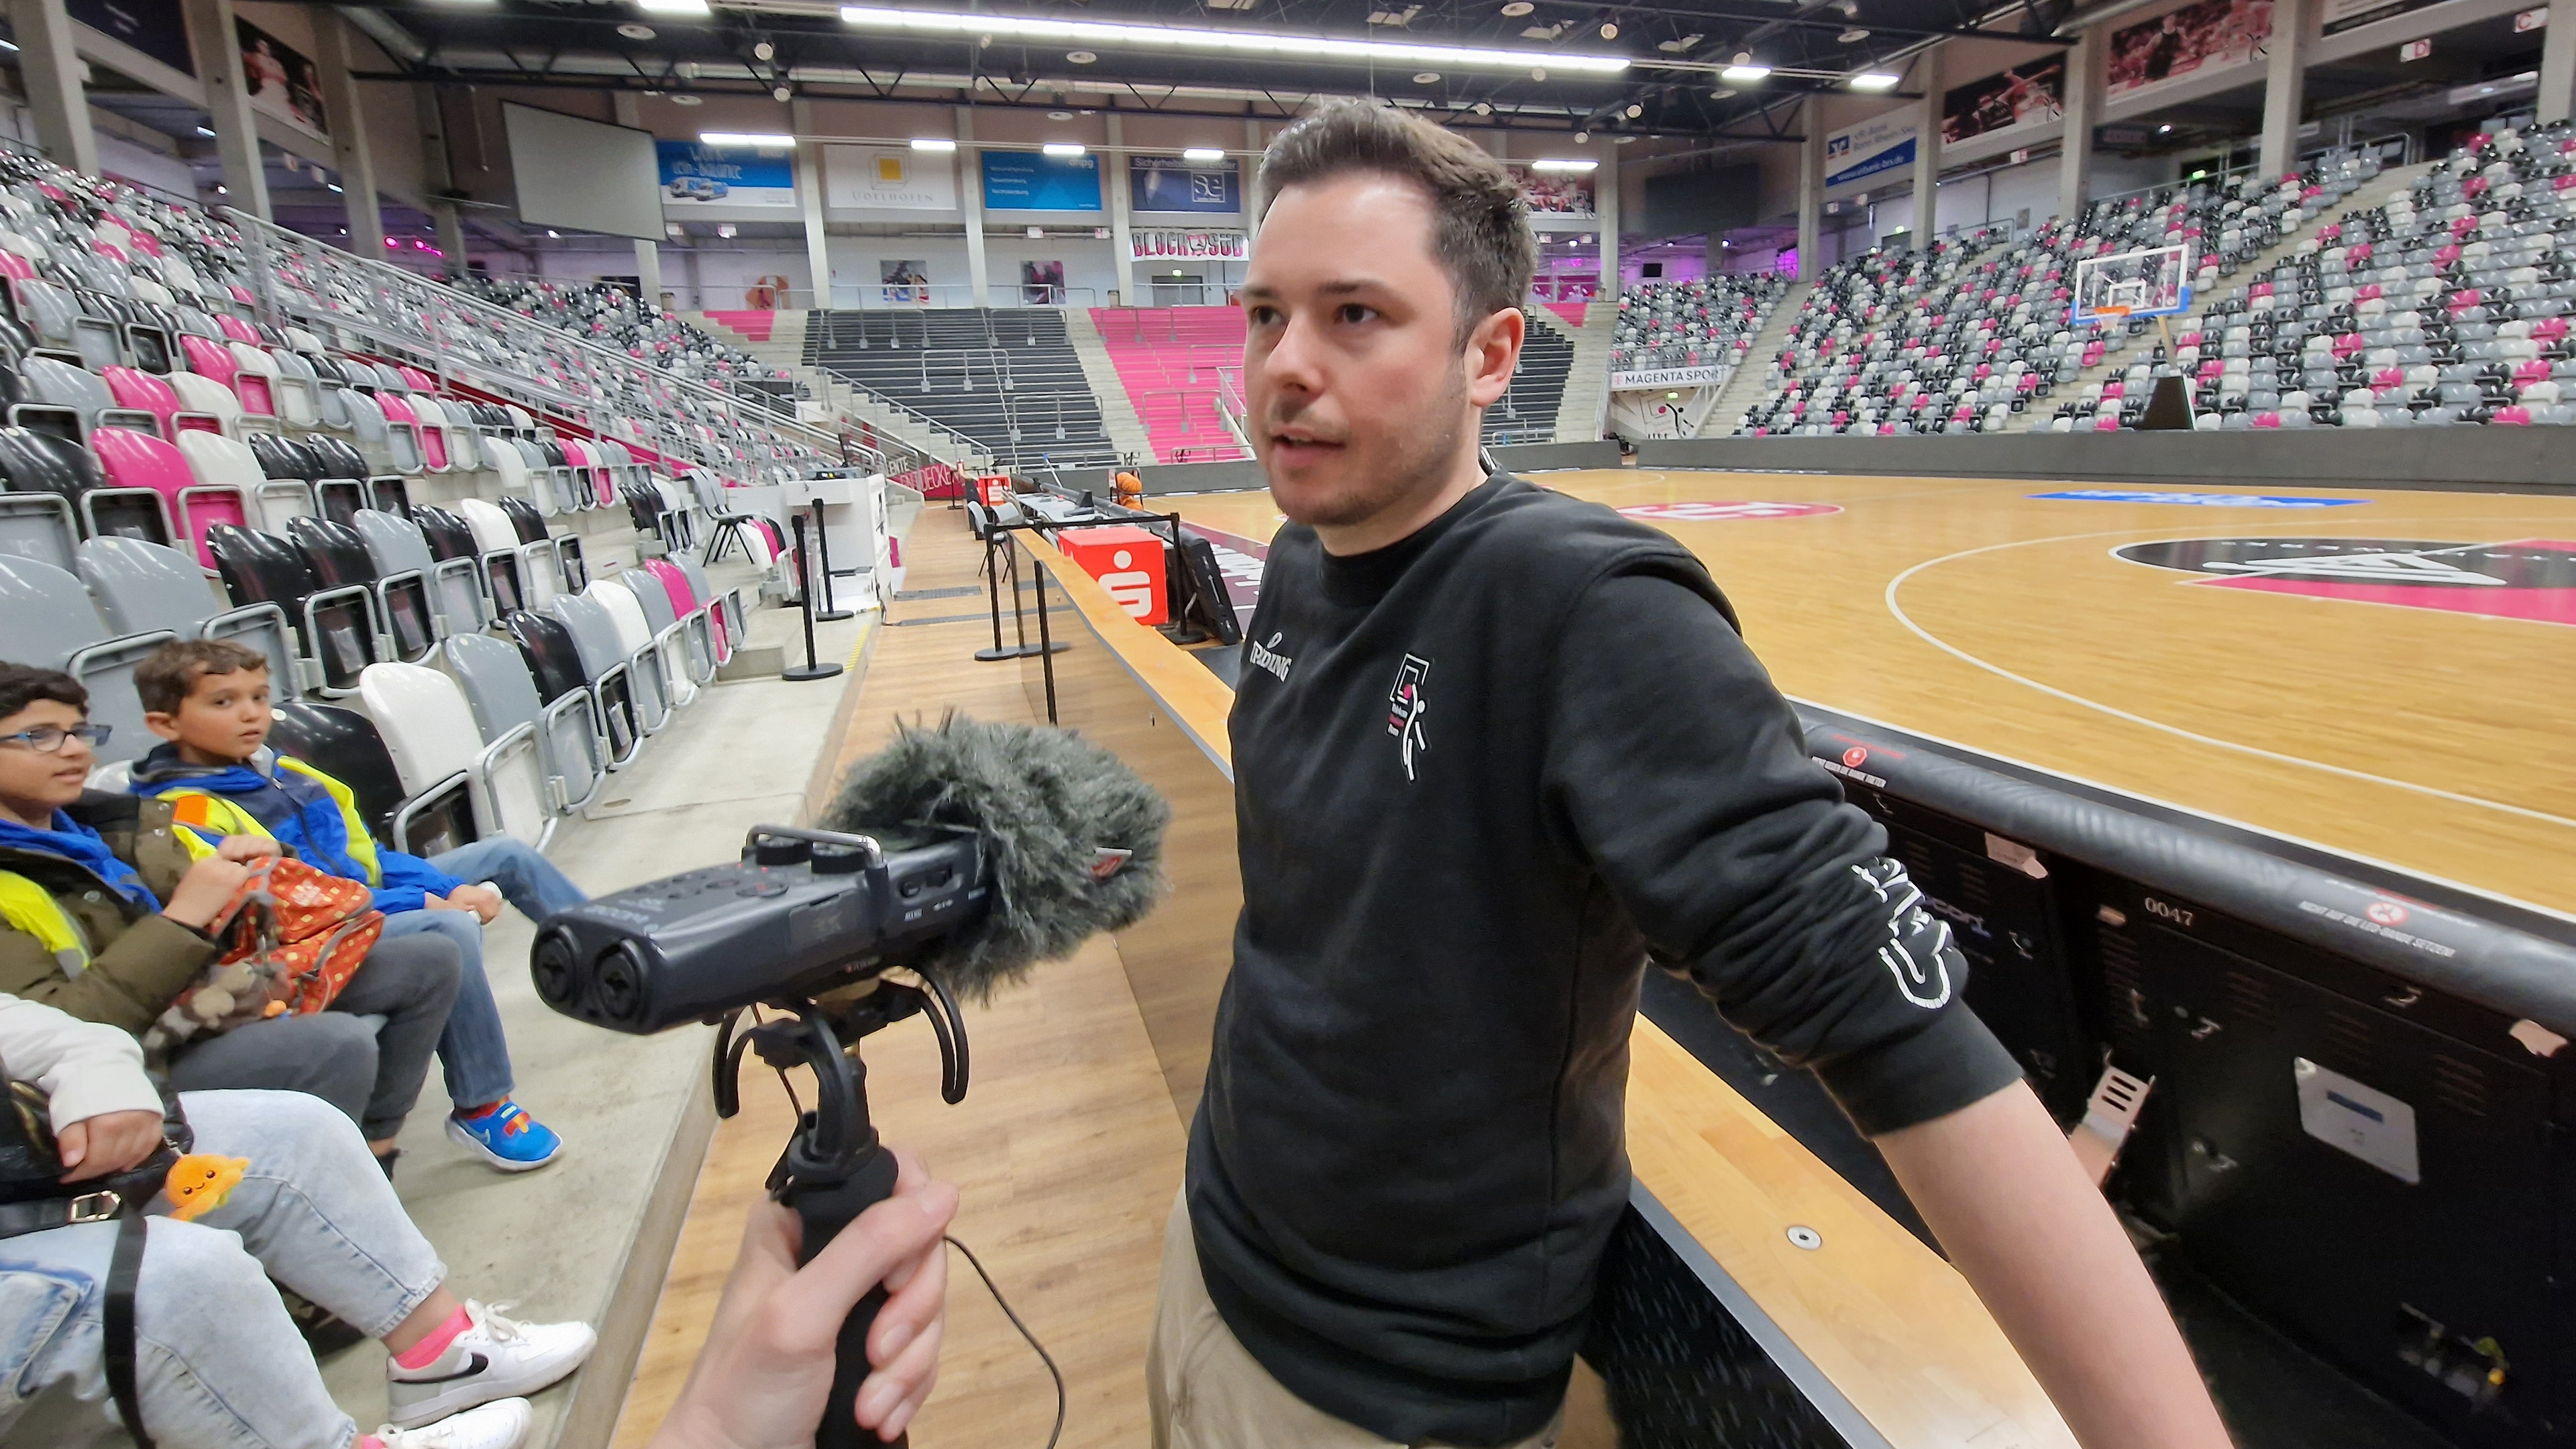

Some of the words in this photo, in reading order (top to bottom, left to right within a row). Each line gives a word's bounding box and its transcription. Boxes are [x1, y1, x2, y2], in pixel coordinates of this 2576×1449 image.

[1132, 232, 1189, 257] BLOCK
[1625, 371, 1684, 384] MAGENTA
[2145, 897, 2193, 926] 0047
